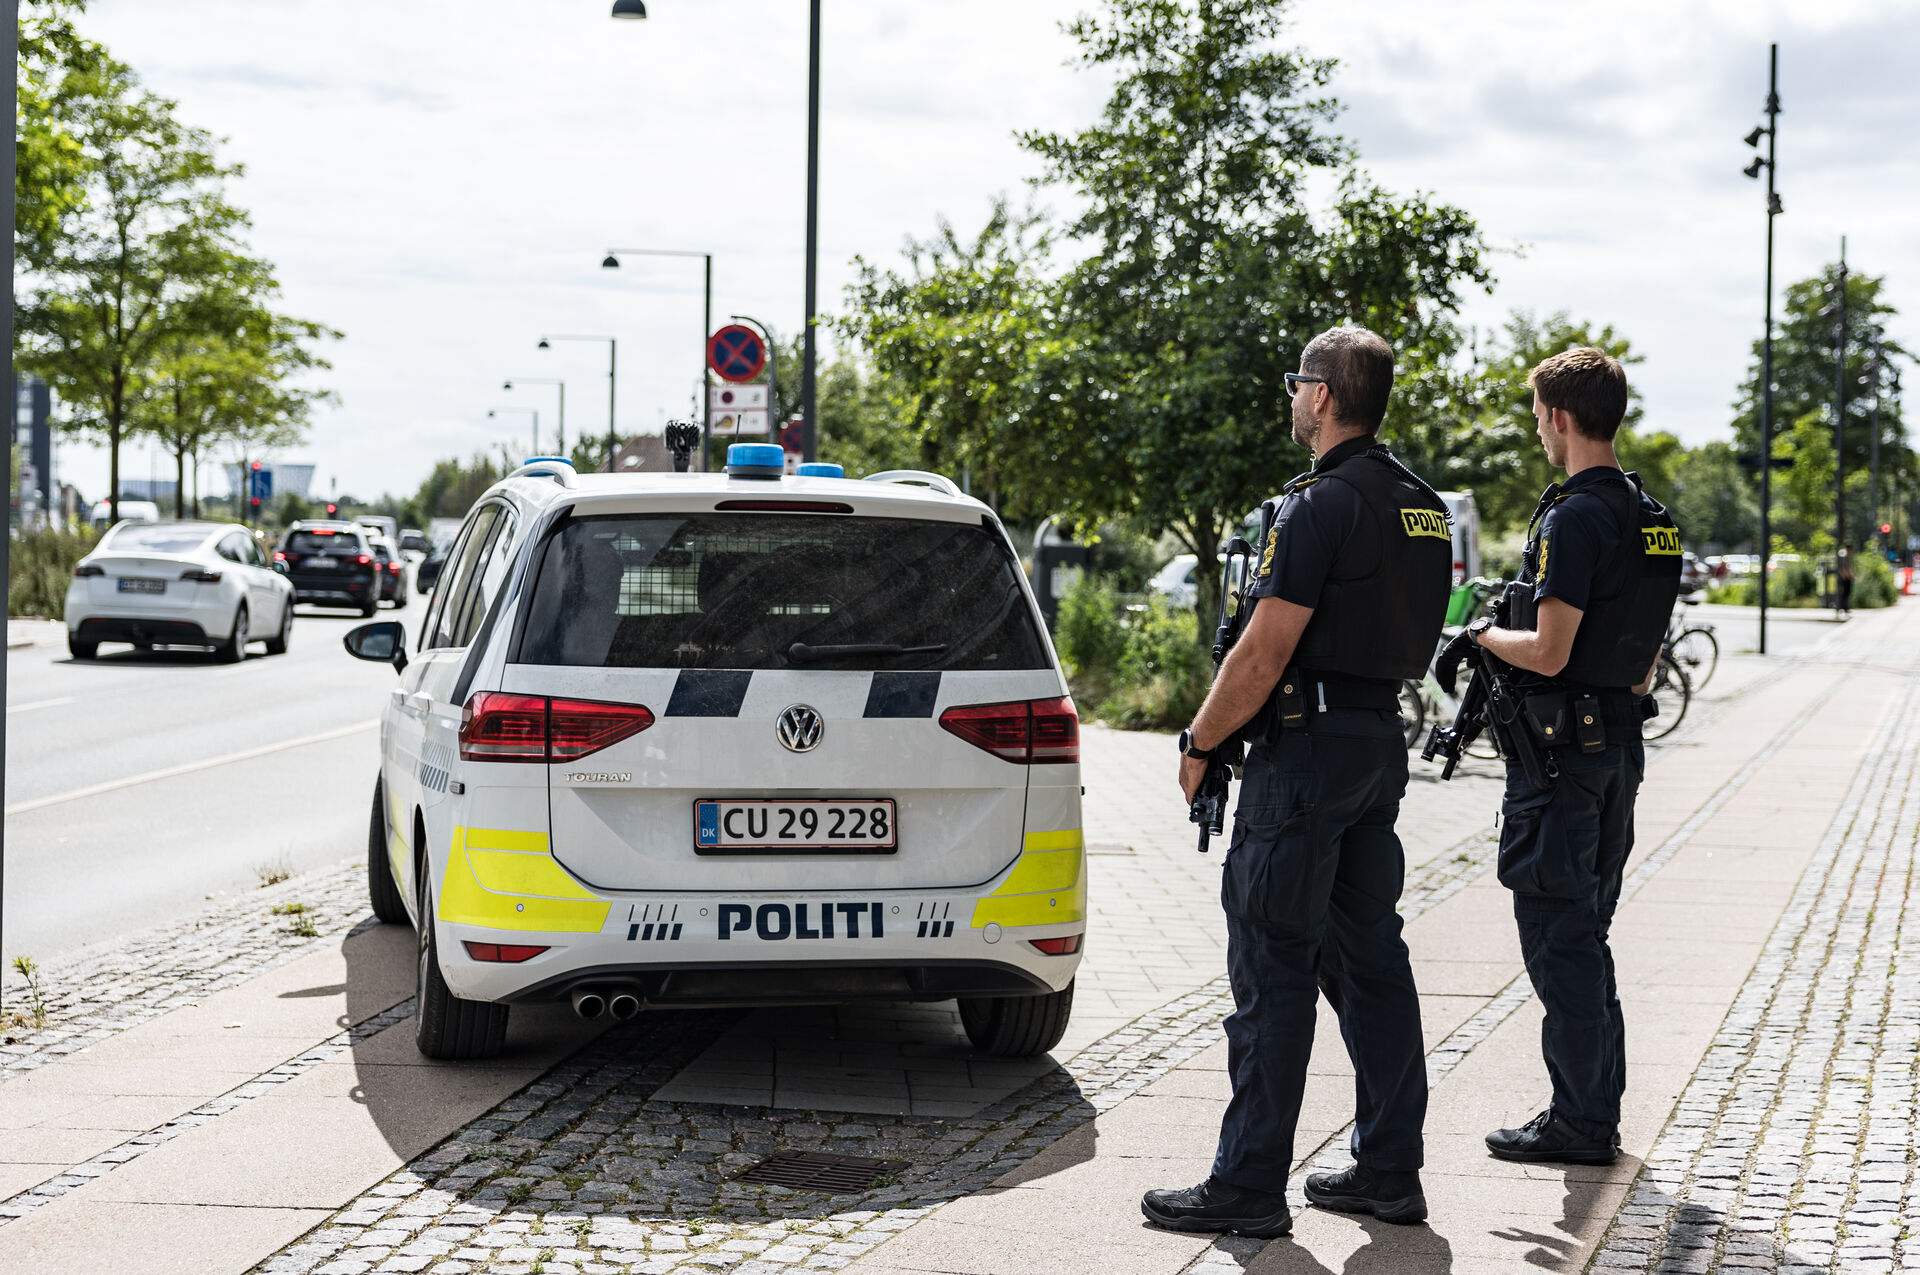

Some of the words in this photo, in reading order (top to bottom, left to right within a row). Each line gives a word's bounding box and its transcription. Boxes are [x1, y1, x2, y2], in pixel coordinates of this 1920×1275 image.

[564, 772, 632, 783] TOURAN
[702, 828, 716, 838] DK
[723, 808, 768, 839] CU
[778, 808, 819, 840] 29
[827, 807, 889, 839] 228
[717, 902, 884, 941] POLITI
